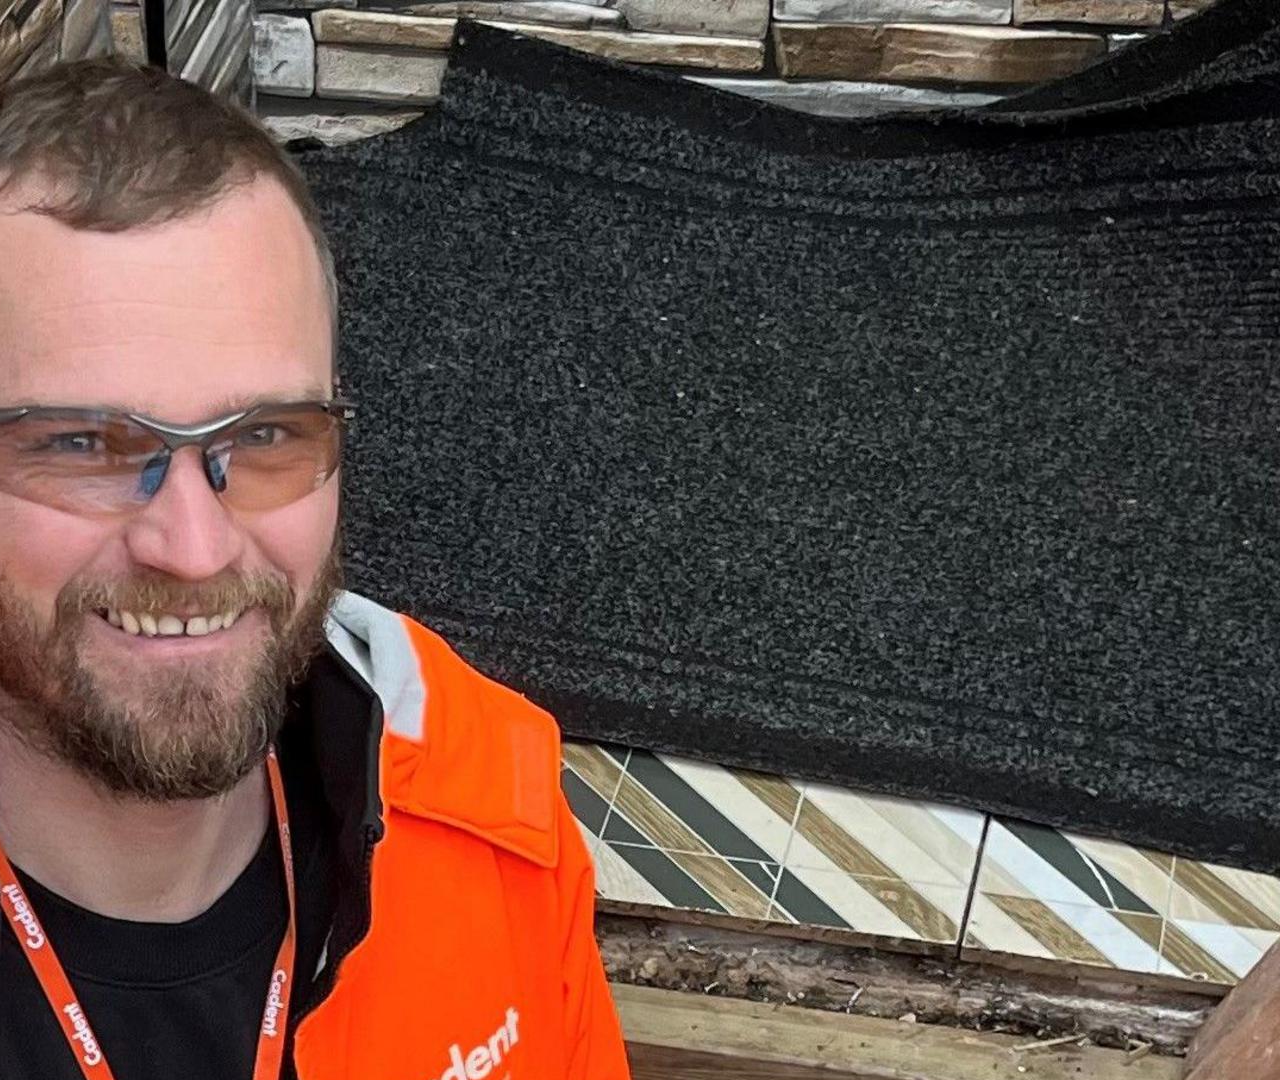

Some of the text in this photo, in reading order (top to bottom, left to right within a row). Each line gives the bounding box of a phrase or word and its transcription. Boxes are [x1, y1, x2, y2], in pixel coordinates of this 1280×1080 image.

[1, 884, 45, 950] Cadent
[63, 1002, 103, 1067] Cadent
[262, 968, 287, 1038] Cadent
